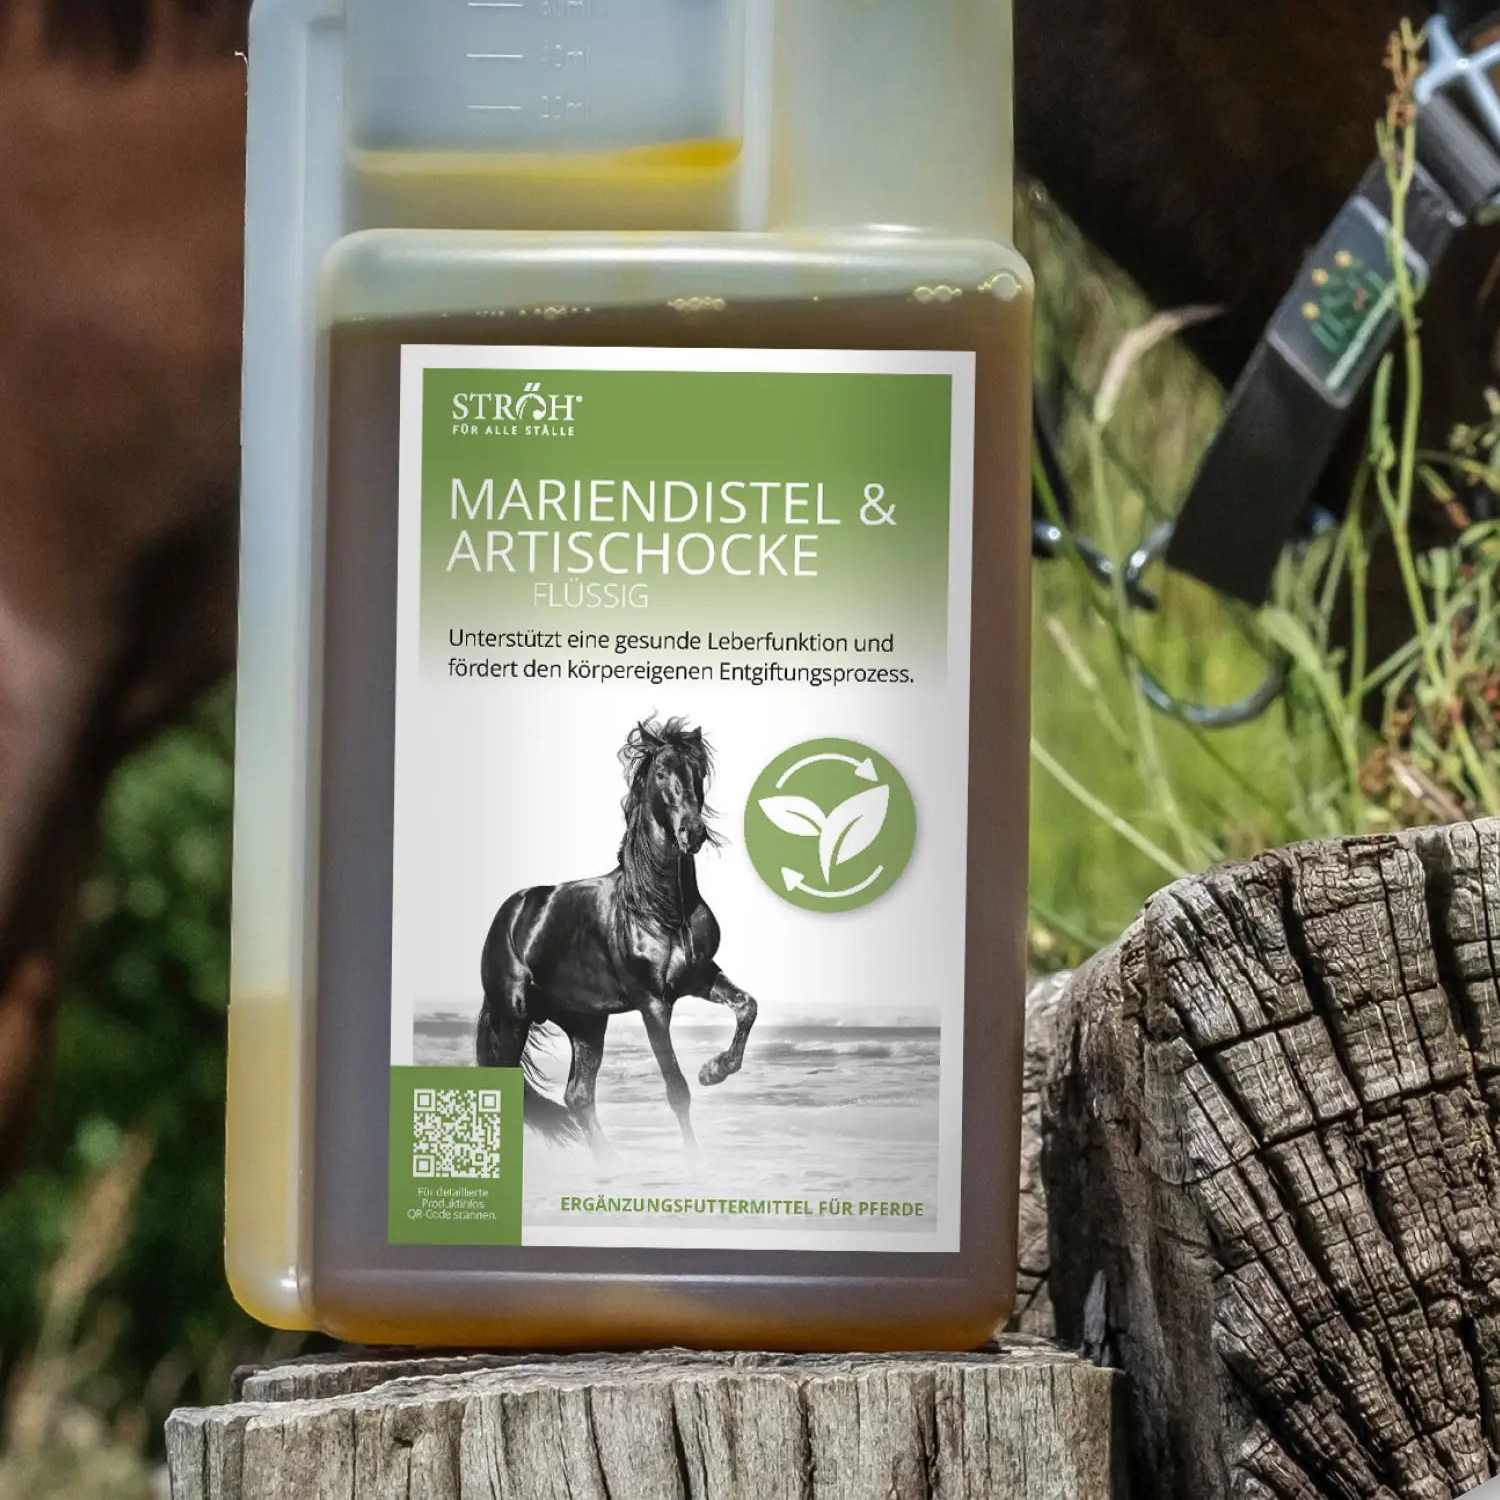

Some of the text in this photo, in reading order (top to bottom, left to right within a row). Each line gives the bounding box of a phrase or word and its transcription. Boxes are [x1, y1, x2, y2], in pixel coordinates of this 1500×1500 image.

[452, 423, 575, 437] FÜR ALLE STÄLLE
[451, 477, 897, 526] MARIENDISTEL &
[446, 529, 819, 577] ARTISCHOCKE
[533, 577, 649, 609] FLÜSSIG
[449, 628, 894, 655] Unterstützt eine gesunde Leberfunktion und
[448, 657, 914, 688] fördert den körpereigenen Entgiftungsprozess.
[407, 1209, 452, 1220] QR-Code
[560, 1194, 925, 1218] ERGÄNZUNGSFUTTERMITTEL FÜR PFERDE
